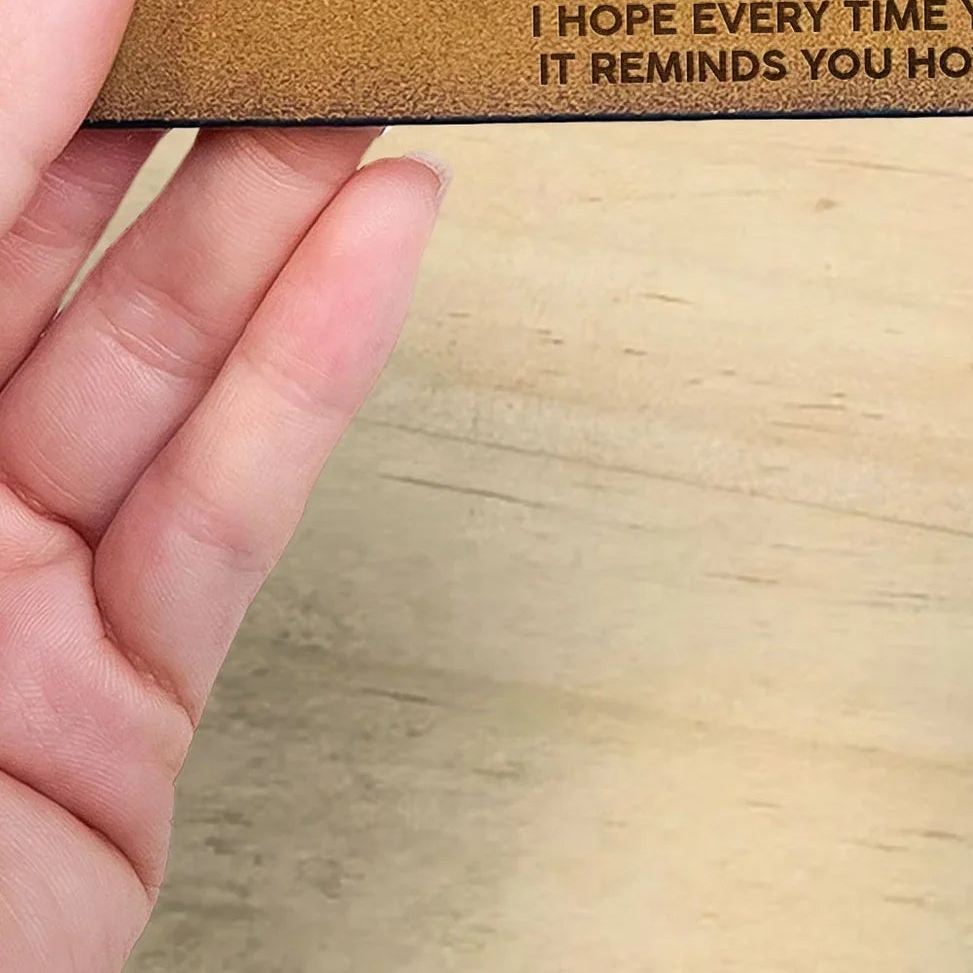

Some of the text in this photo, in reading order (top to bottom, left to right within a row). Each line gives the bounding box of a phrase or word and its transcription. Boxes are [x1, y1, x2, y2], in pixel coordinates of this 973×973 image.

[533, 5, 542, 38] I
[558, 2, 677, 37] HOPE
[693, 0, 830, 35] EVERY
[540, 52, 576, 86] IT
[591, 49, 788, 85] REMINDS
[800, 47, 893, 81] YOU
